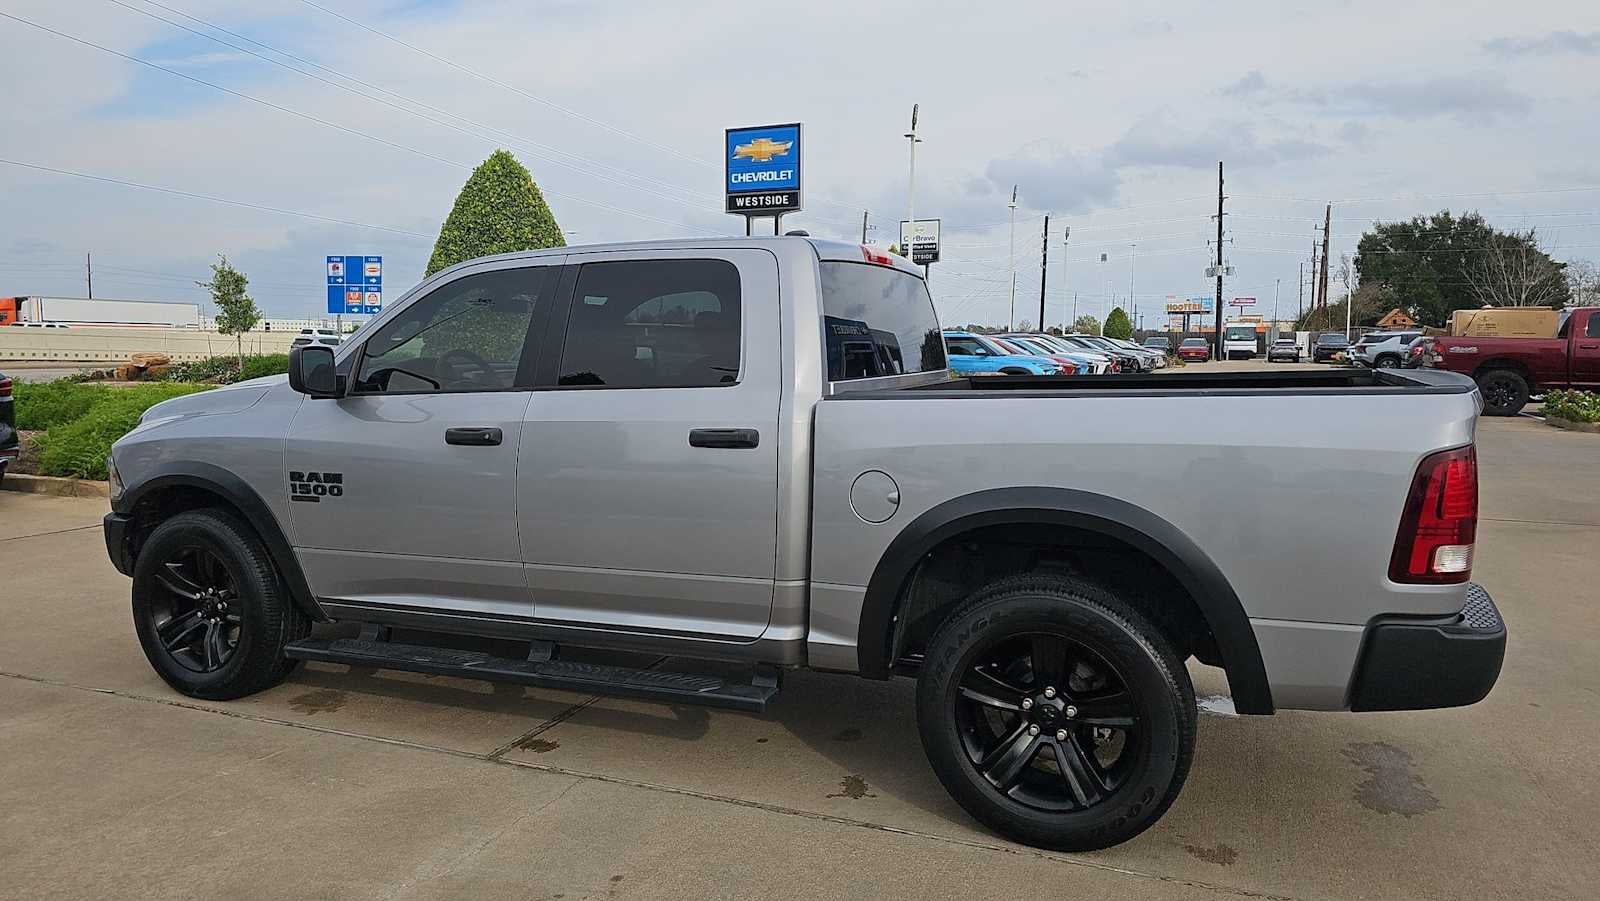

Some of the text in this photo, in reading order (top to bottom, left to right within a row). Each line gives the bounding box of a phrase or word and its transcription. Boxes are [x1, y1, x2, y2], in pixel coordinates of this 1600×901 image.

[731, 170, 793, 184] CHEVROLET
[736, 195, 789, 207] WESTSIDE
[903, 234, 936, 242] CrBravo
[289, 471, 343, 484] RAM
[290, 483, 343, 497] 1500
